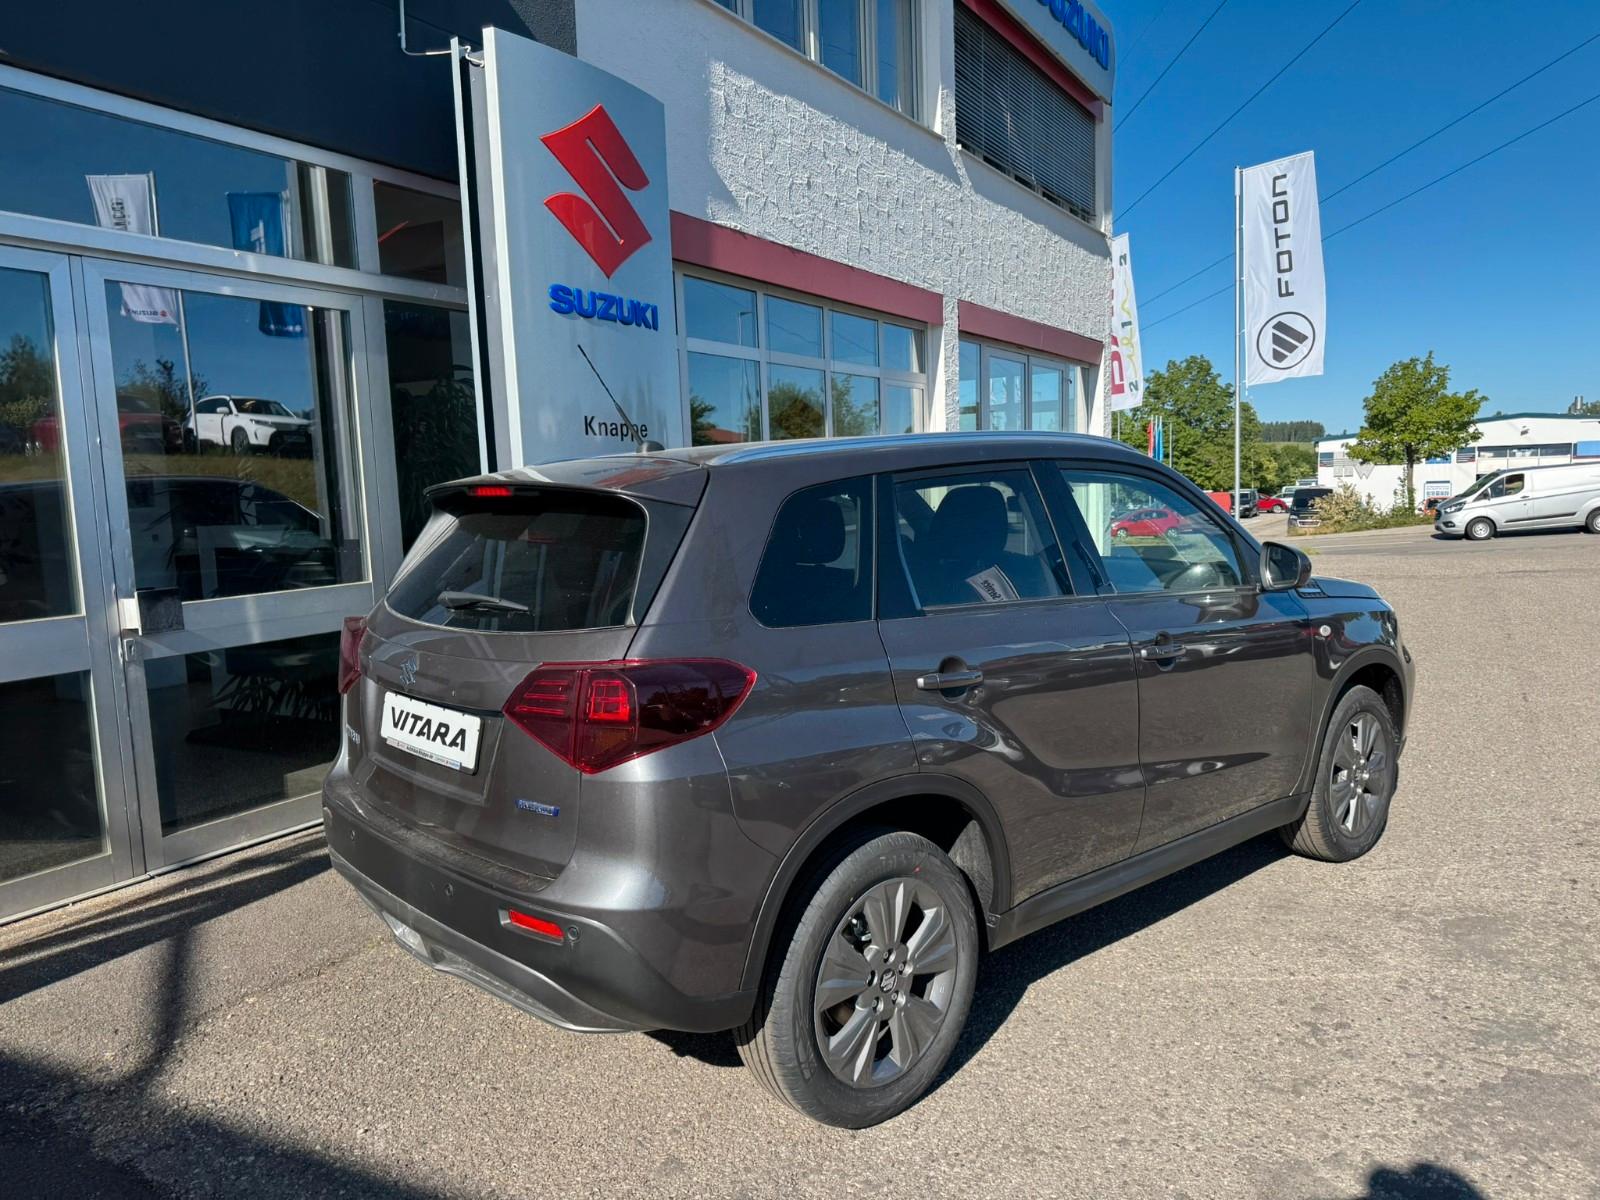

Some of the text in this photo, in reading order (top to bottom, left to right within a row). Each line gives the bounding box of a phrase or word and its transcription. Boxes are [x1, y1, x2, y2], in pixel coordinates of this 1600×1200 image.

[1036, 0, 1109, 71] UZUKI
[1271, 173, 1295, 298] FOTON
[549, 283, 659, 331] SUZUKI
[583, 415, 649, 442] Knappe
[391, 705, 467, 752] VITARA
